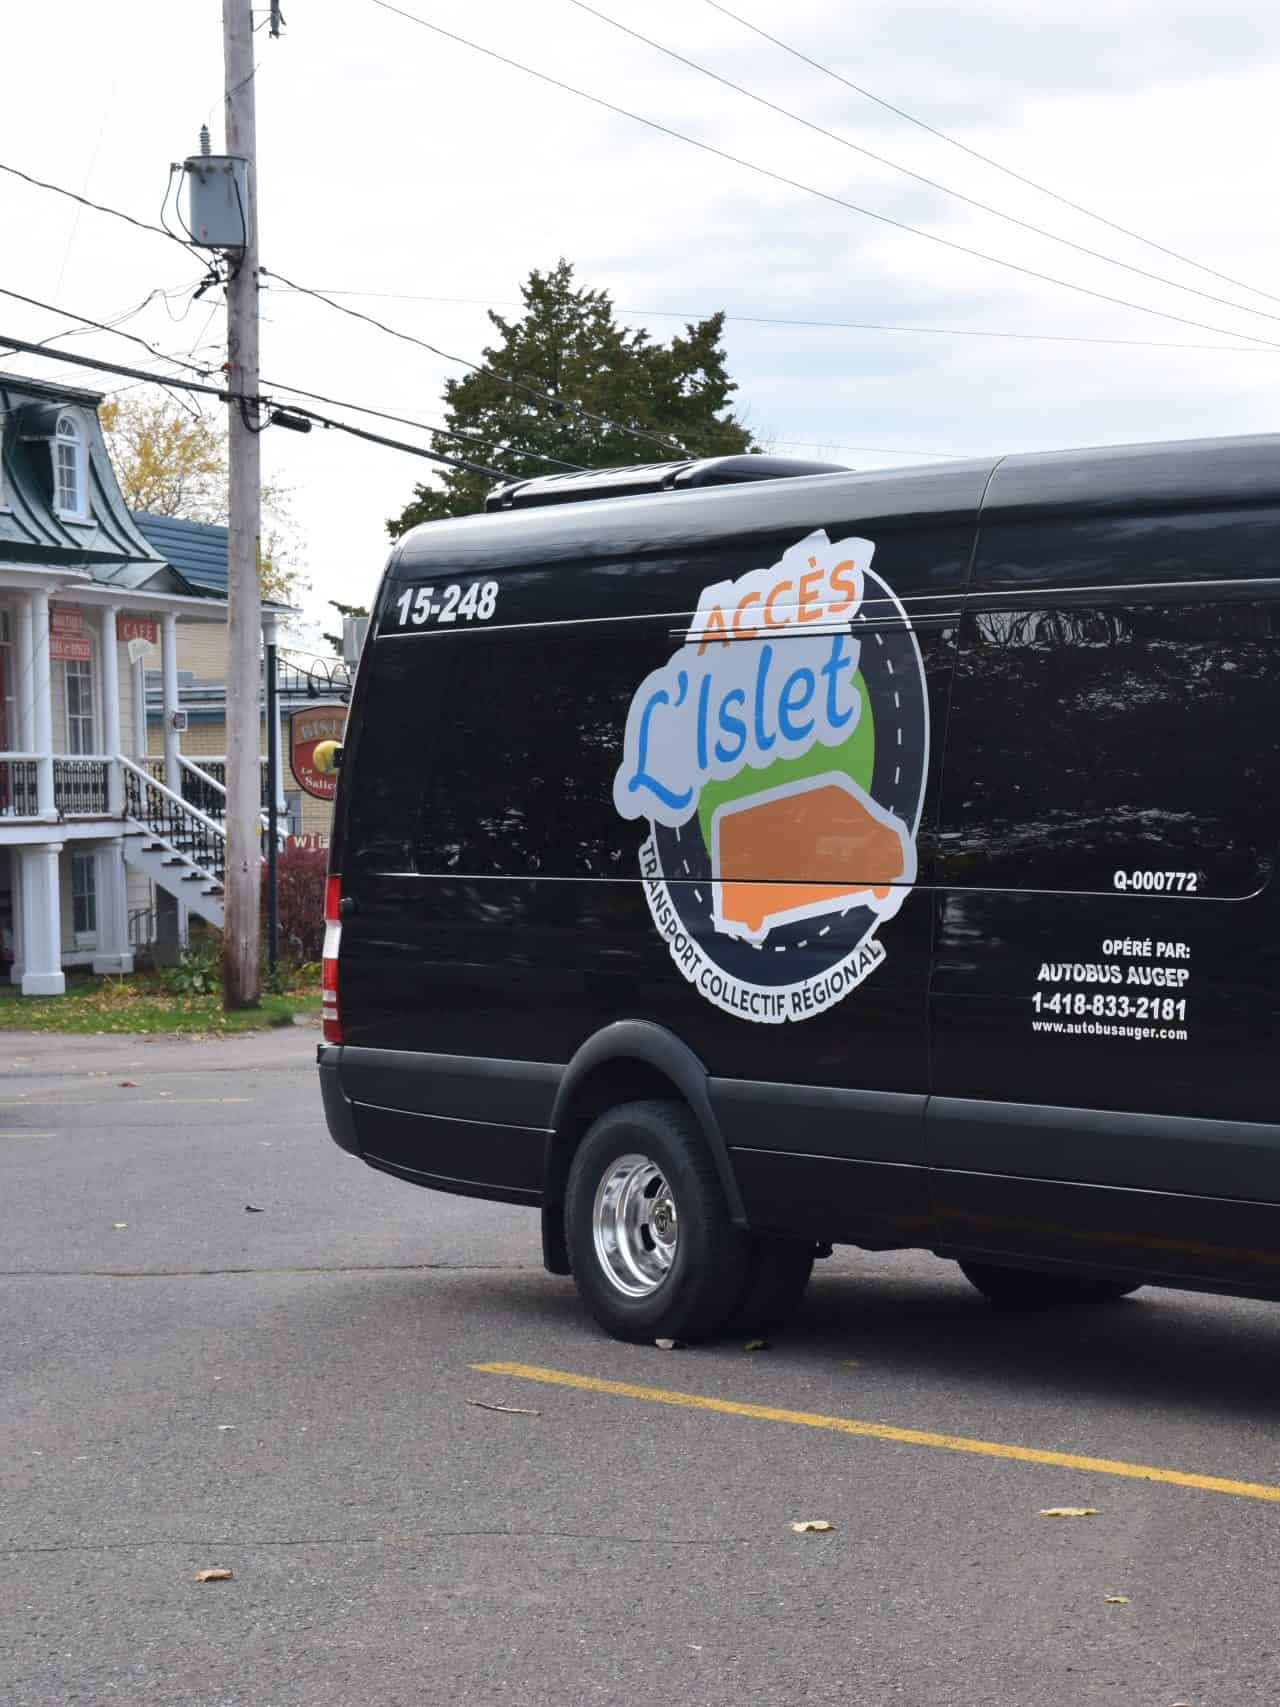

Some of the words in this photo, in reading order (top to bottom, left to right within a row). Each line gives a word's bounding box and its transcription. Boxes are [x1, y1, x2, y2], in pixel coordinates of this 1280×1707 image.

[397, 581, 499, 626] 15-248
[697, 556, 856, 656] ACCÈS
[628, 634, 854, 810] L'Islet
[1113, 870, 1198, 892] Q-000772
[643, 842, 702, 974] TRANSPORT
[701, 968, 786, 1016] COLLECTIF
[791, 943, 881, 1014] RÉGIONAL
[1102, 937, 1152, 957] OPÉRÉ
[1156, 942, 1191, 959] PAR:
[1037, 963, 1122, 984] AUTOBUS
[1032, 991, 1187, 1021] 1-418-833-2181
[1032, 1020, 1188, 1041] www.autobusauger.com
